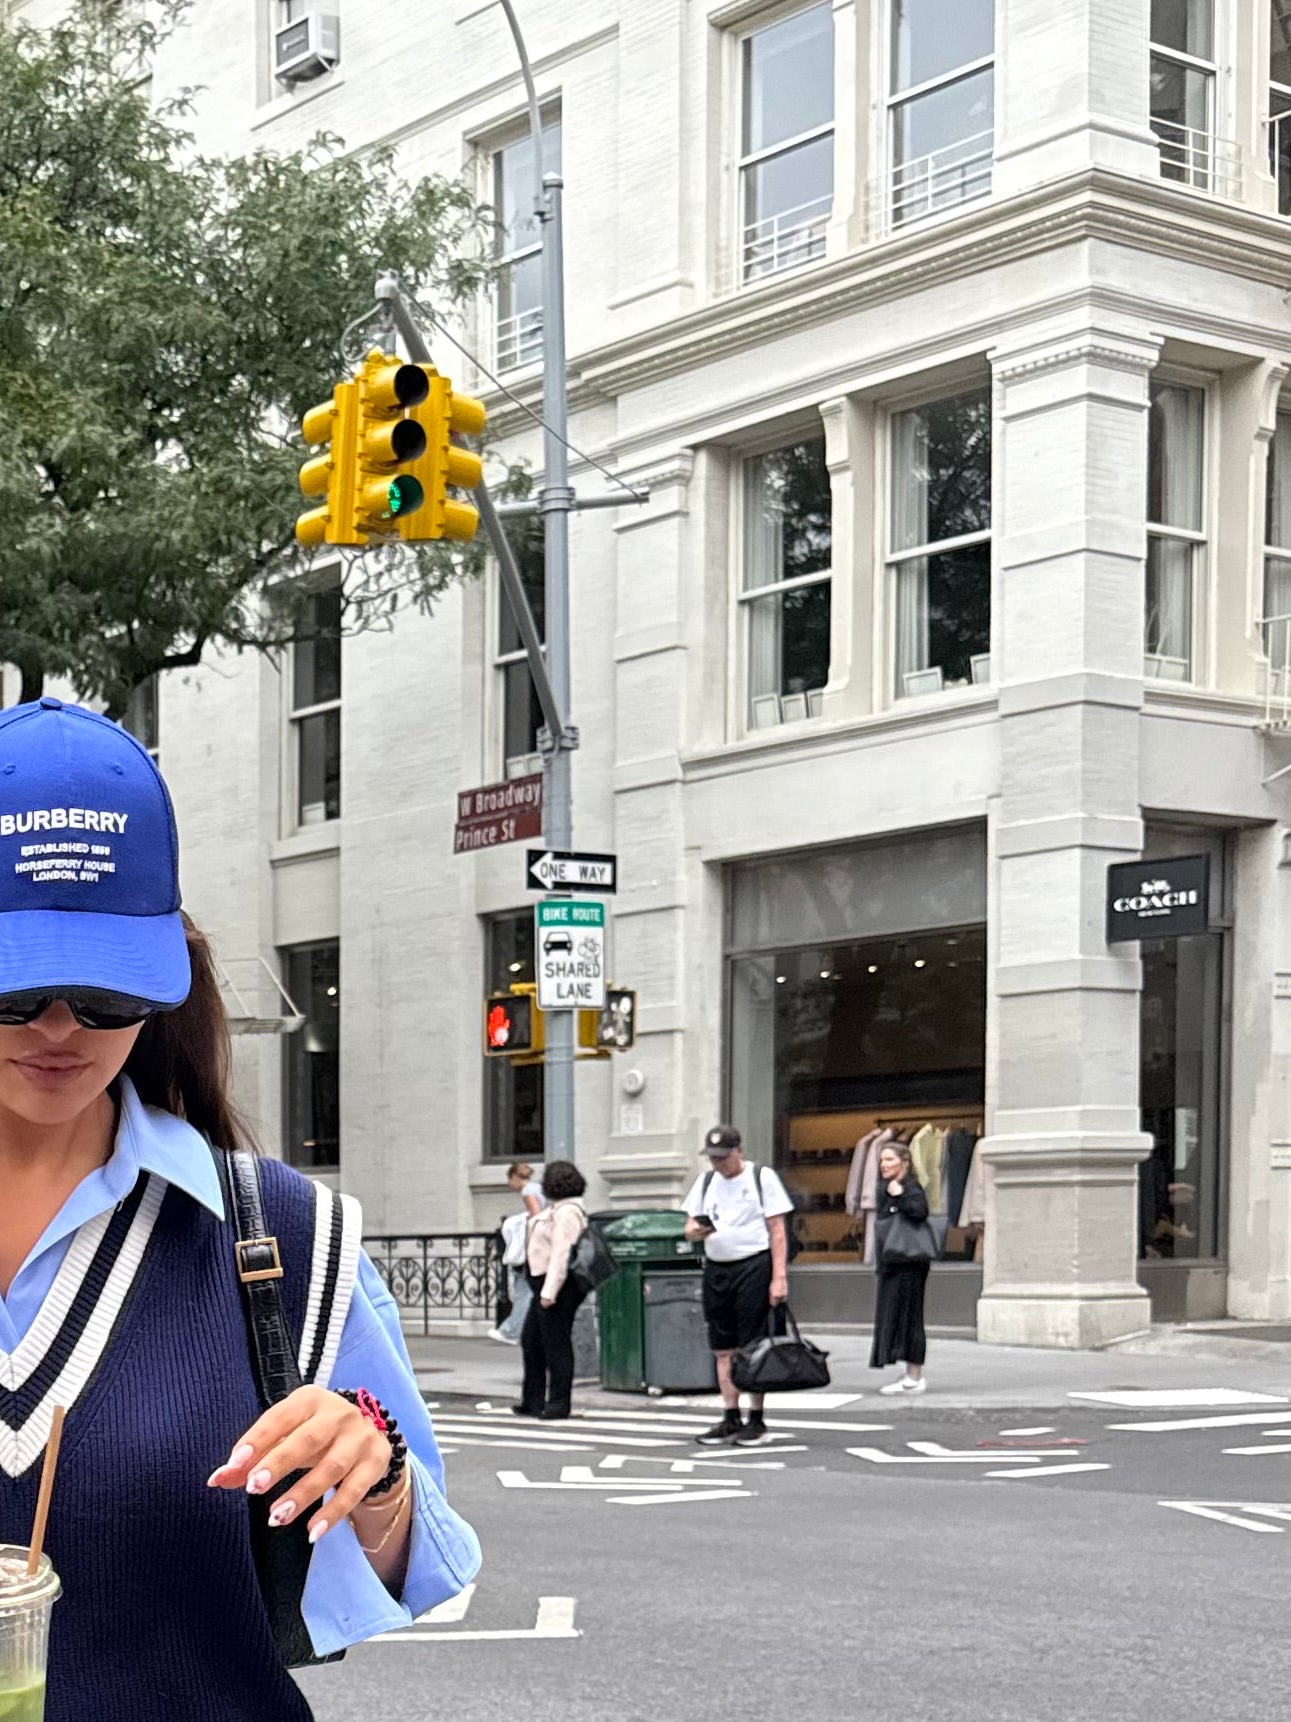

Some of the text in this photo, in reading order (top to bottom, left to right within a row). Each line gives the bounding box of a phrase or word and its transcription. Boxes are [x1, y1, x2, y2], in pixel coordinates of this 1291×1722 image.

[461, 796, 472, 817] W
[475, 782, 541, 814] Broadway
[0, 808, 128, 836] BURBERRY
[456, 818, 515, 850] Prince St
[20, 843, 89, 856] ESTABLISHED
[84, 861, 115, 872] HOUSE
[540, 862, 606, 882] ONE WAY
[33, 870, 78, 882] LONDON,
[1113, 890, 1197, 912] COACH
[543, 907, 600, 922] BIKE ROUTE
[545, 962, 600, 978] SHARED
[556, 983, 592, 999] LANE
